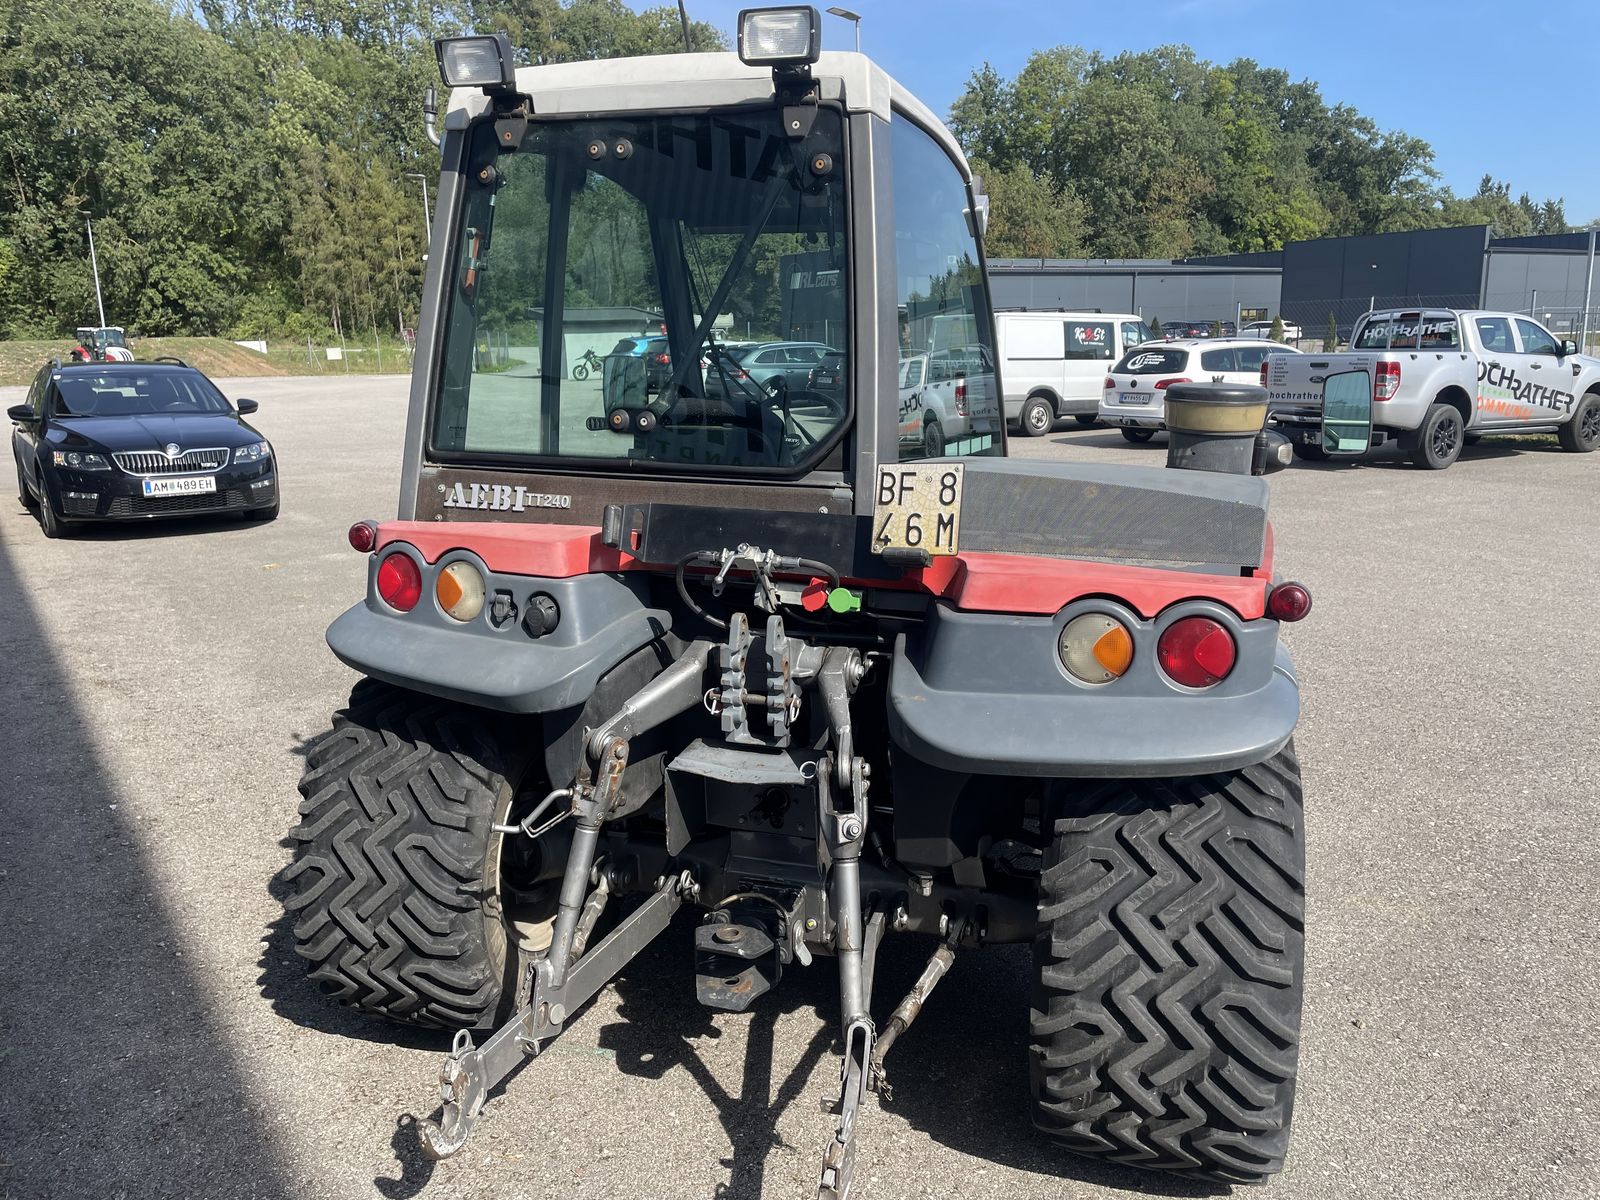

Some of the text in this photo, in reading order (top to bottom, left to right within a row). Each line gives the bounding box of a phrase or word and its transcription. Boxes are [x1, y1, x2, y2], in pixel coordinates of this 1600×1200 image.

[153, 479, 213, 493] AM 489 EH
[443, 482, 572, 512] AEBI TT240
[878, 471, 957, 506] BF 8
